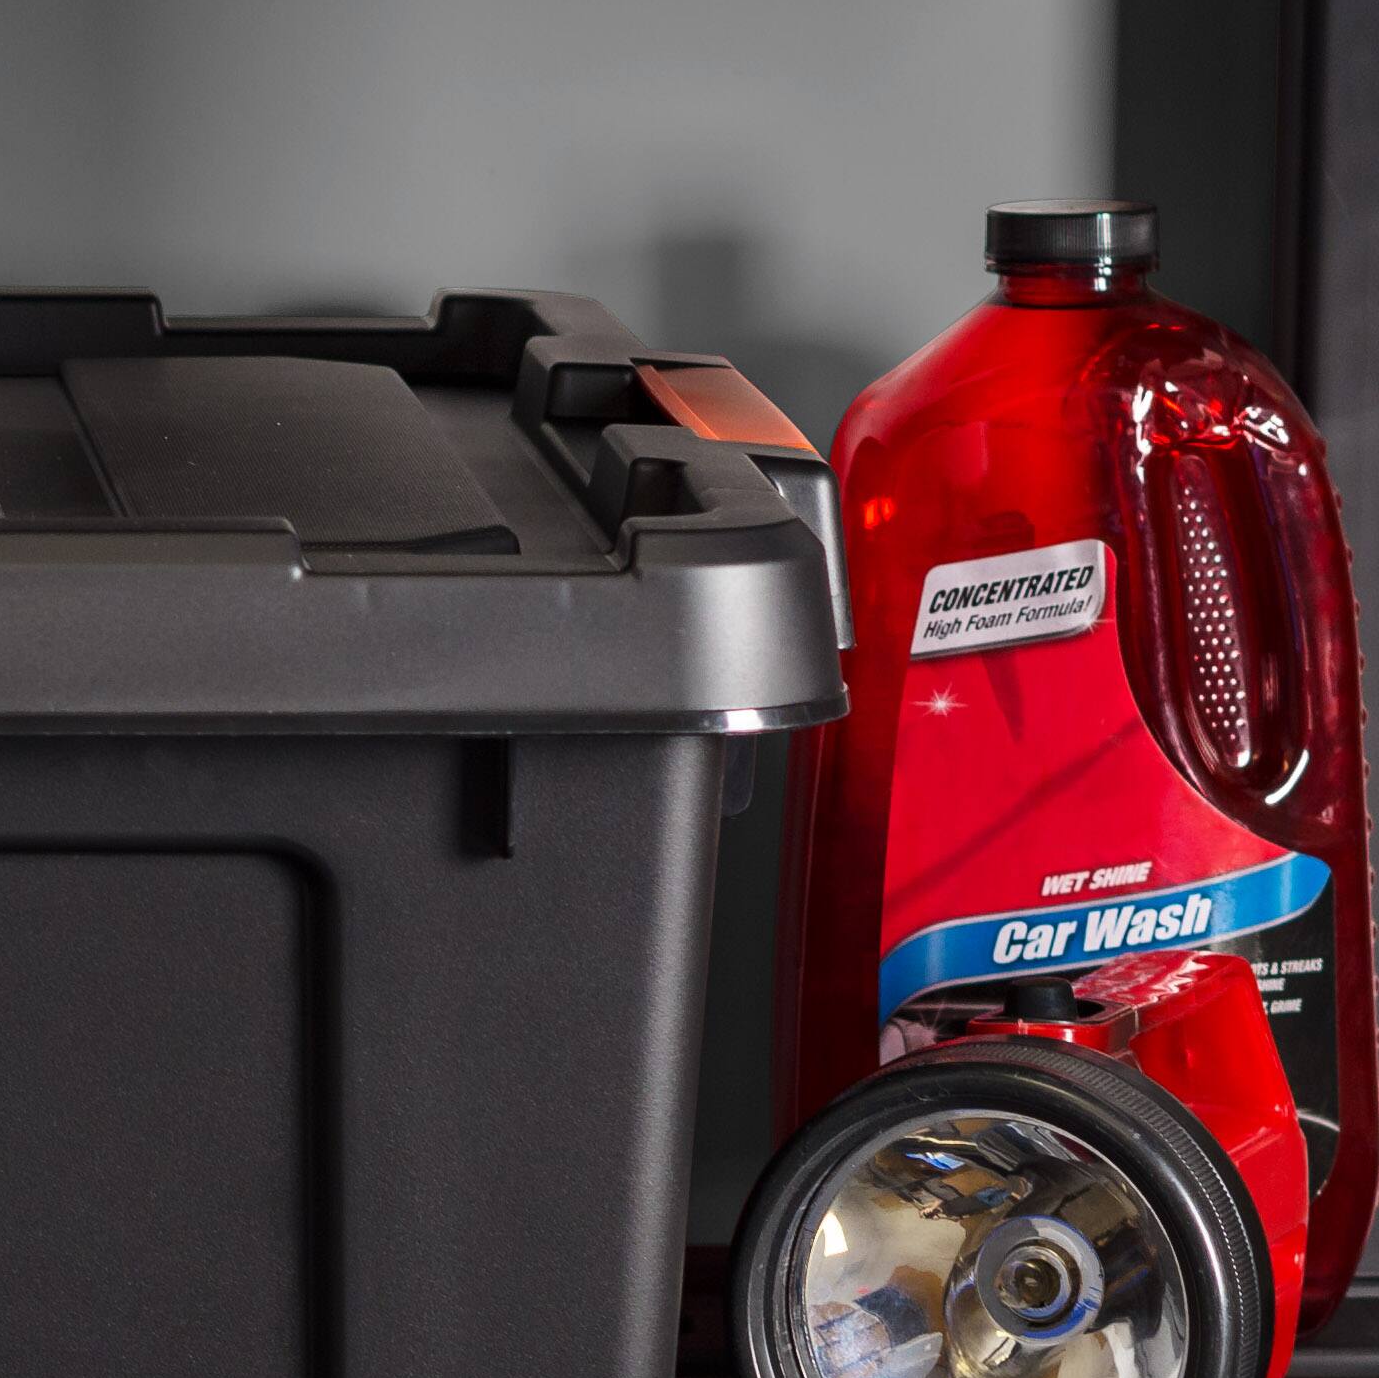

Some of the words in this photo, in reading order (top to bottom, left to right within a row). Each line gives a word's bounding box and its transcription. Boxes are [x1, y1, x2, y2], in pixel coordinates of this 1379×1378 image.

[929, 565, 1095, 614] CONCENTRATED
[923, 616, 963, 640] High
[965, 611, 1012, 633] Foam
[1015, 595, 1093, 625] Formula!
[1040, 871, 1090, 897] WET
[1090, 861, 1153, 892] SHINE
[992, 919, 1077, 965] Car
[1084, 893, 1213, 952] Wash
